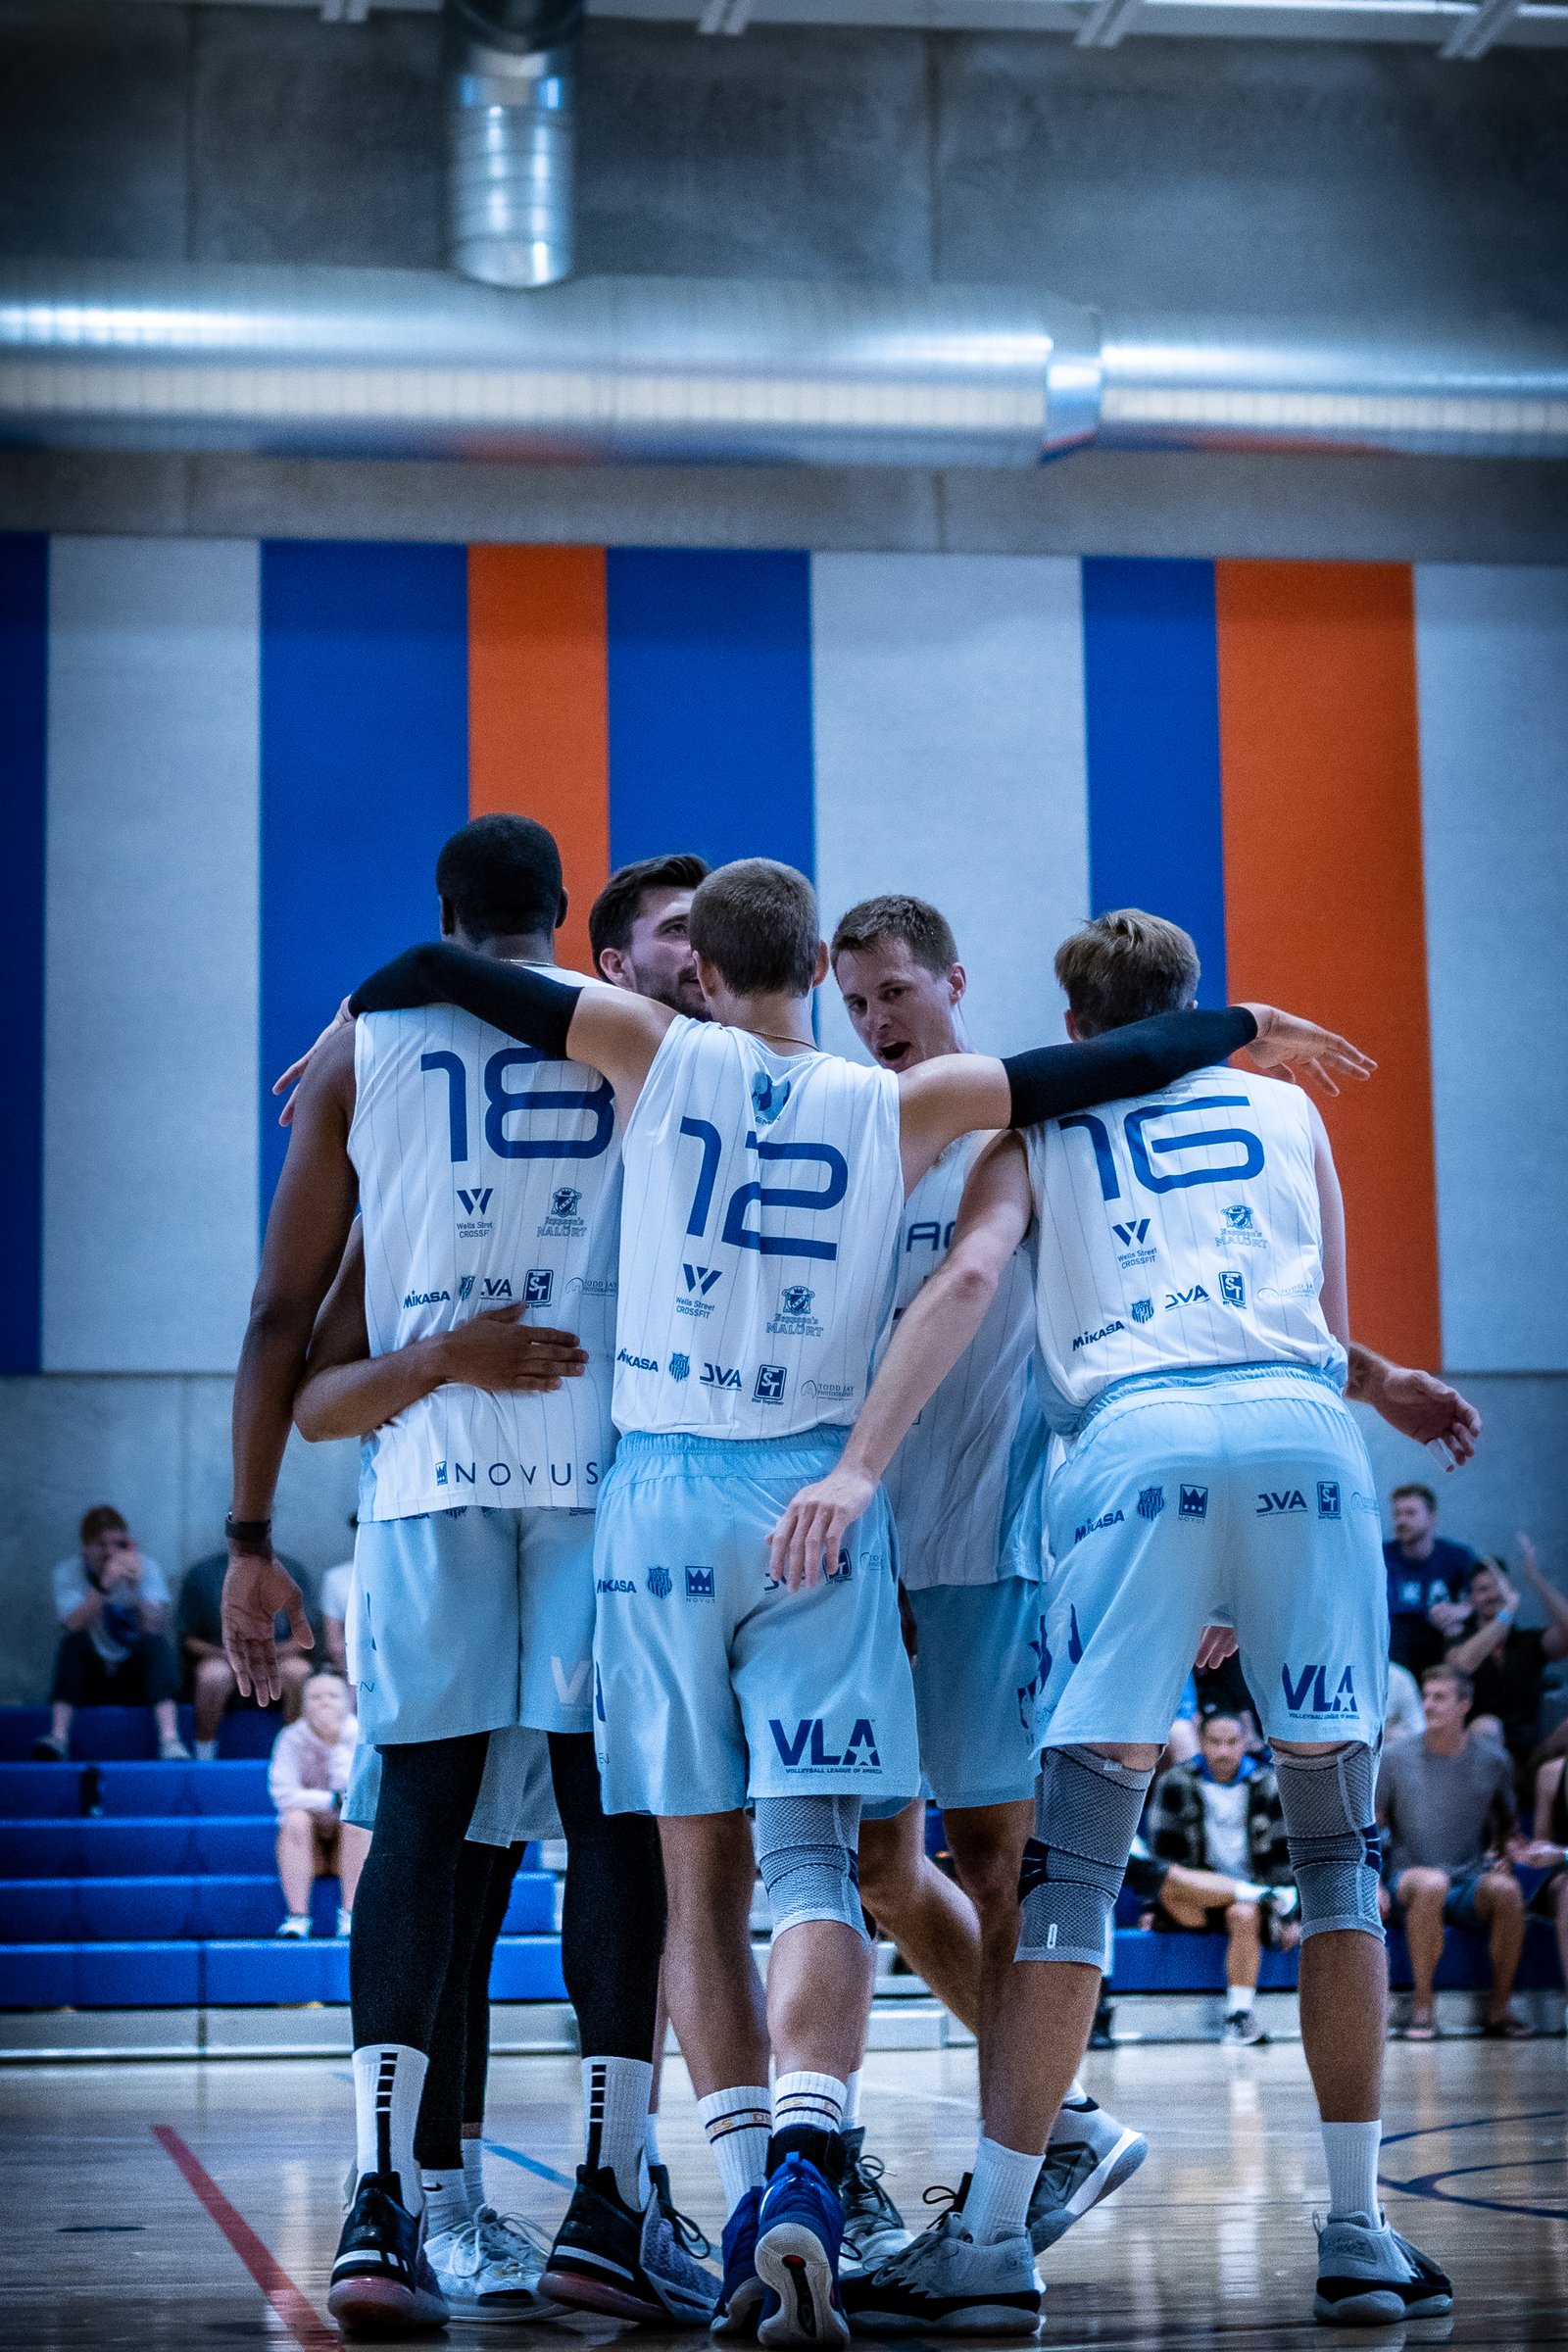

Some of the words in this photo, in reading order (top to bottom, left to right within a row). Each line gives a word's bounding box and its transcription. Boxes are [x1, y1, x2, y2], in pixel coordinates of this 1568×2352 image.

[420, 1047, 614, 1162] 18
[1058, 1095, 1265, 1201] 16
[679, 1115, 849, 1261] 12
[459, 1229, 490, 1239] CROSSF
[1117, 1251, 1136, 1262] Wells
[1137, 1247, 1157, 1257] Street
[1121, 1254, 1156, 1269] CROSSFIT
[480, 1278, 513, 1297] VA
[676, 1296, 693, 1307] Wells
[694, 1299, 715, 1310] Street
[676, 1304, 711, 1319] CROSSFIT
[699, 1362, 742, 1388] JVA
[455, 1461, 599, 1487] NOVUS
[1255, 1490, 1307, 1514] JVA
[1282, 1662, 1358, 1712] VLA
[768, 1719, 881, 1766] VLA
